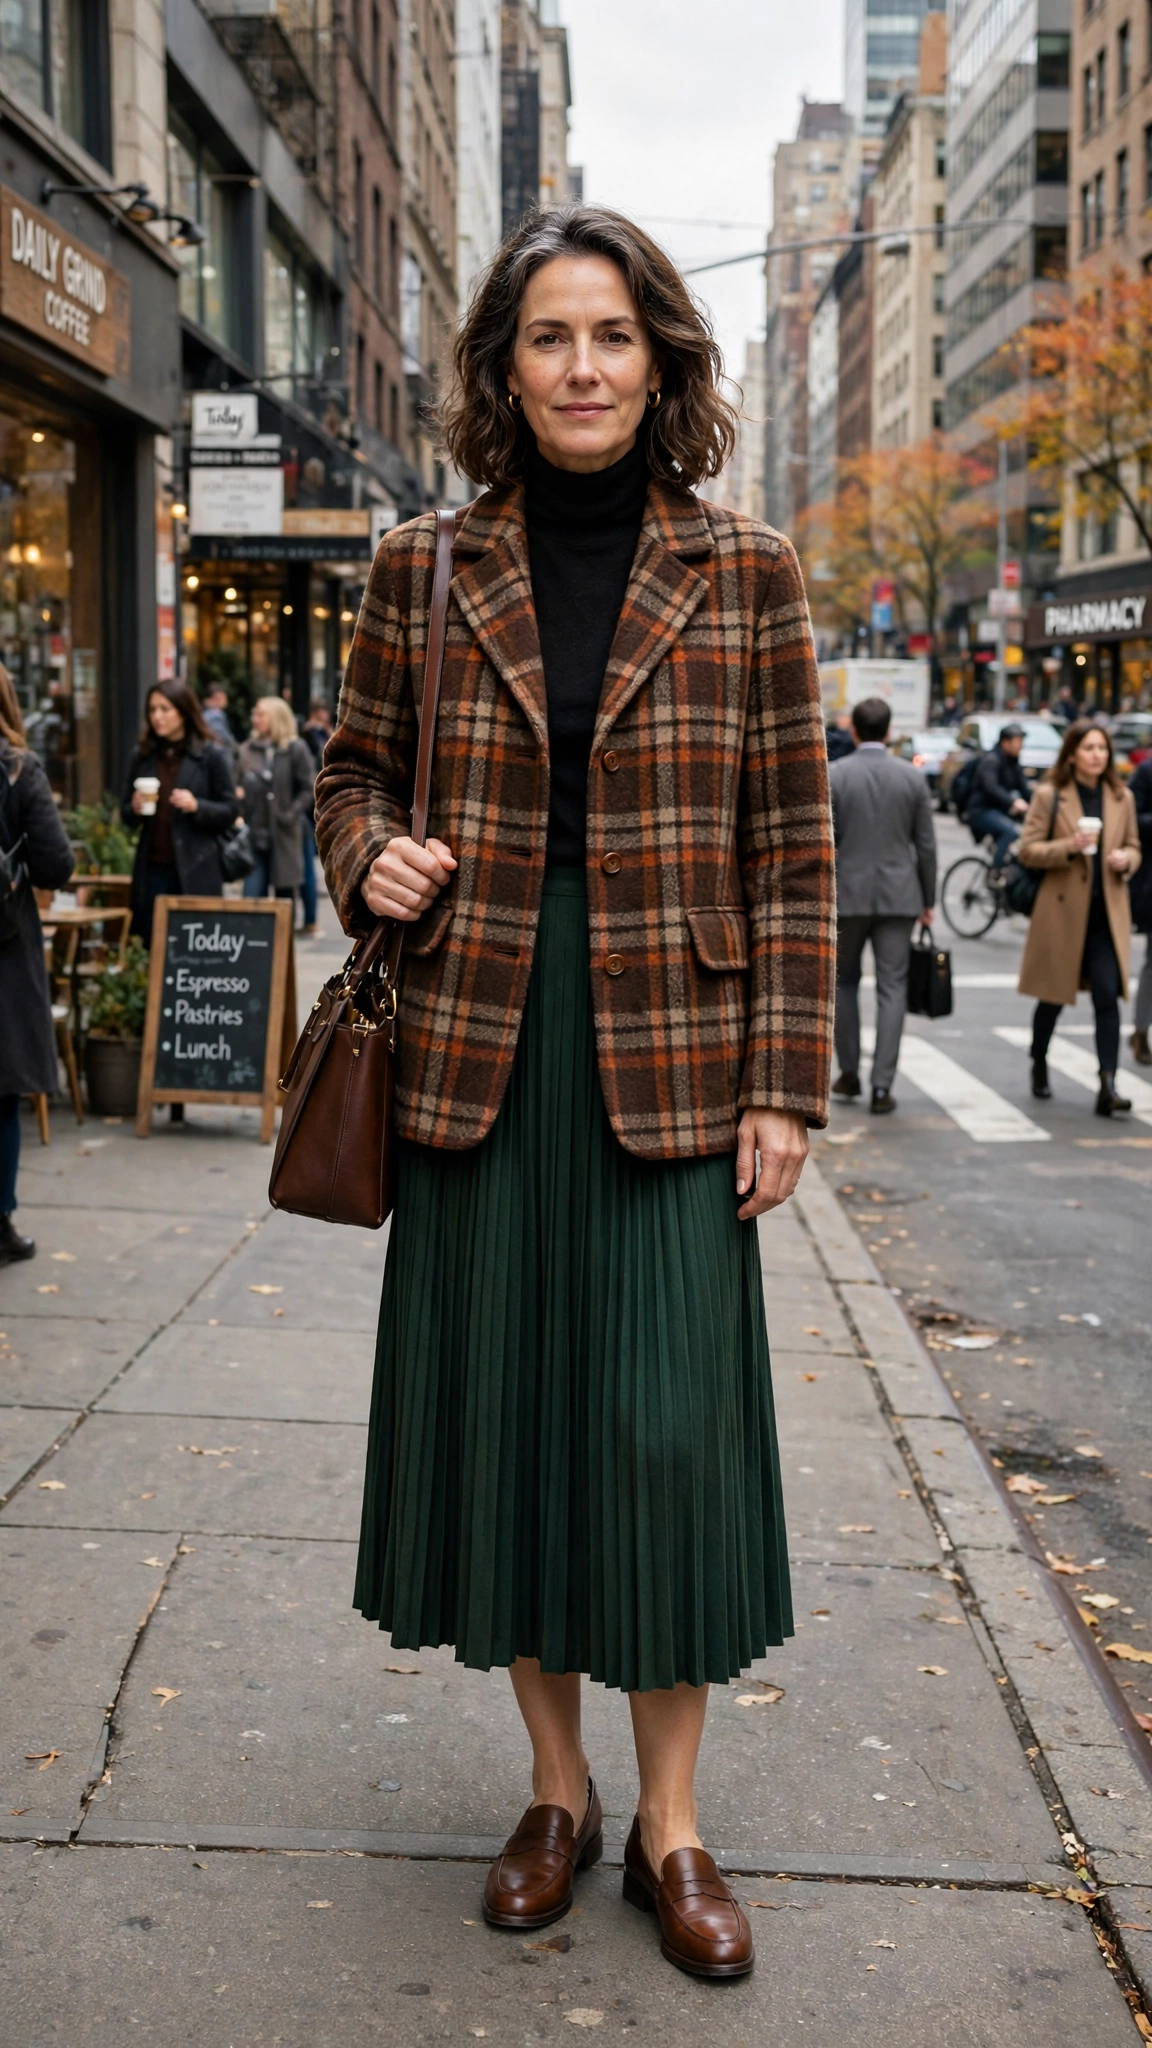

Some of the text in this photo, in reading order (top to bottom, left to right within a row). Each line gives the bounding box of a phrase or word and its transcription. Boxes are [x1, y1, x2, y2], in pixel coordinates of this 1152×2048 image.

[11, 207, 106, 315] DAILY GRIND
[44, 289, 90, 346] COFFEE
[1045, 595, 1147, 637] PHARMACY
[181, 922, 245, 963] Today
[175, 968, 250, 999] Espresso
[174, 998, 243, 1026] Pastries
[174, 1032, 232, 1061] Lunch
